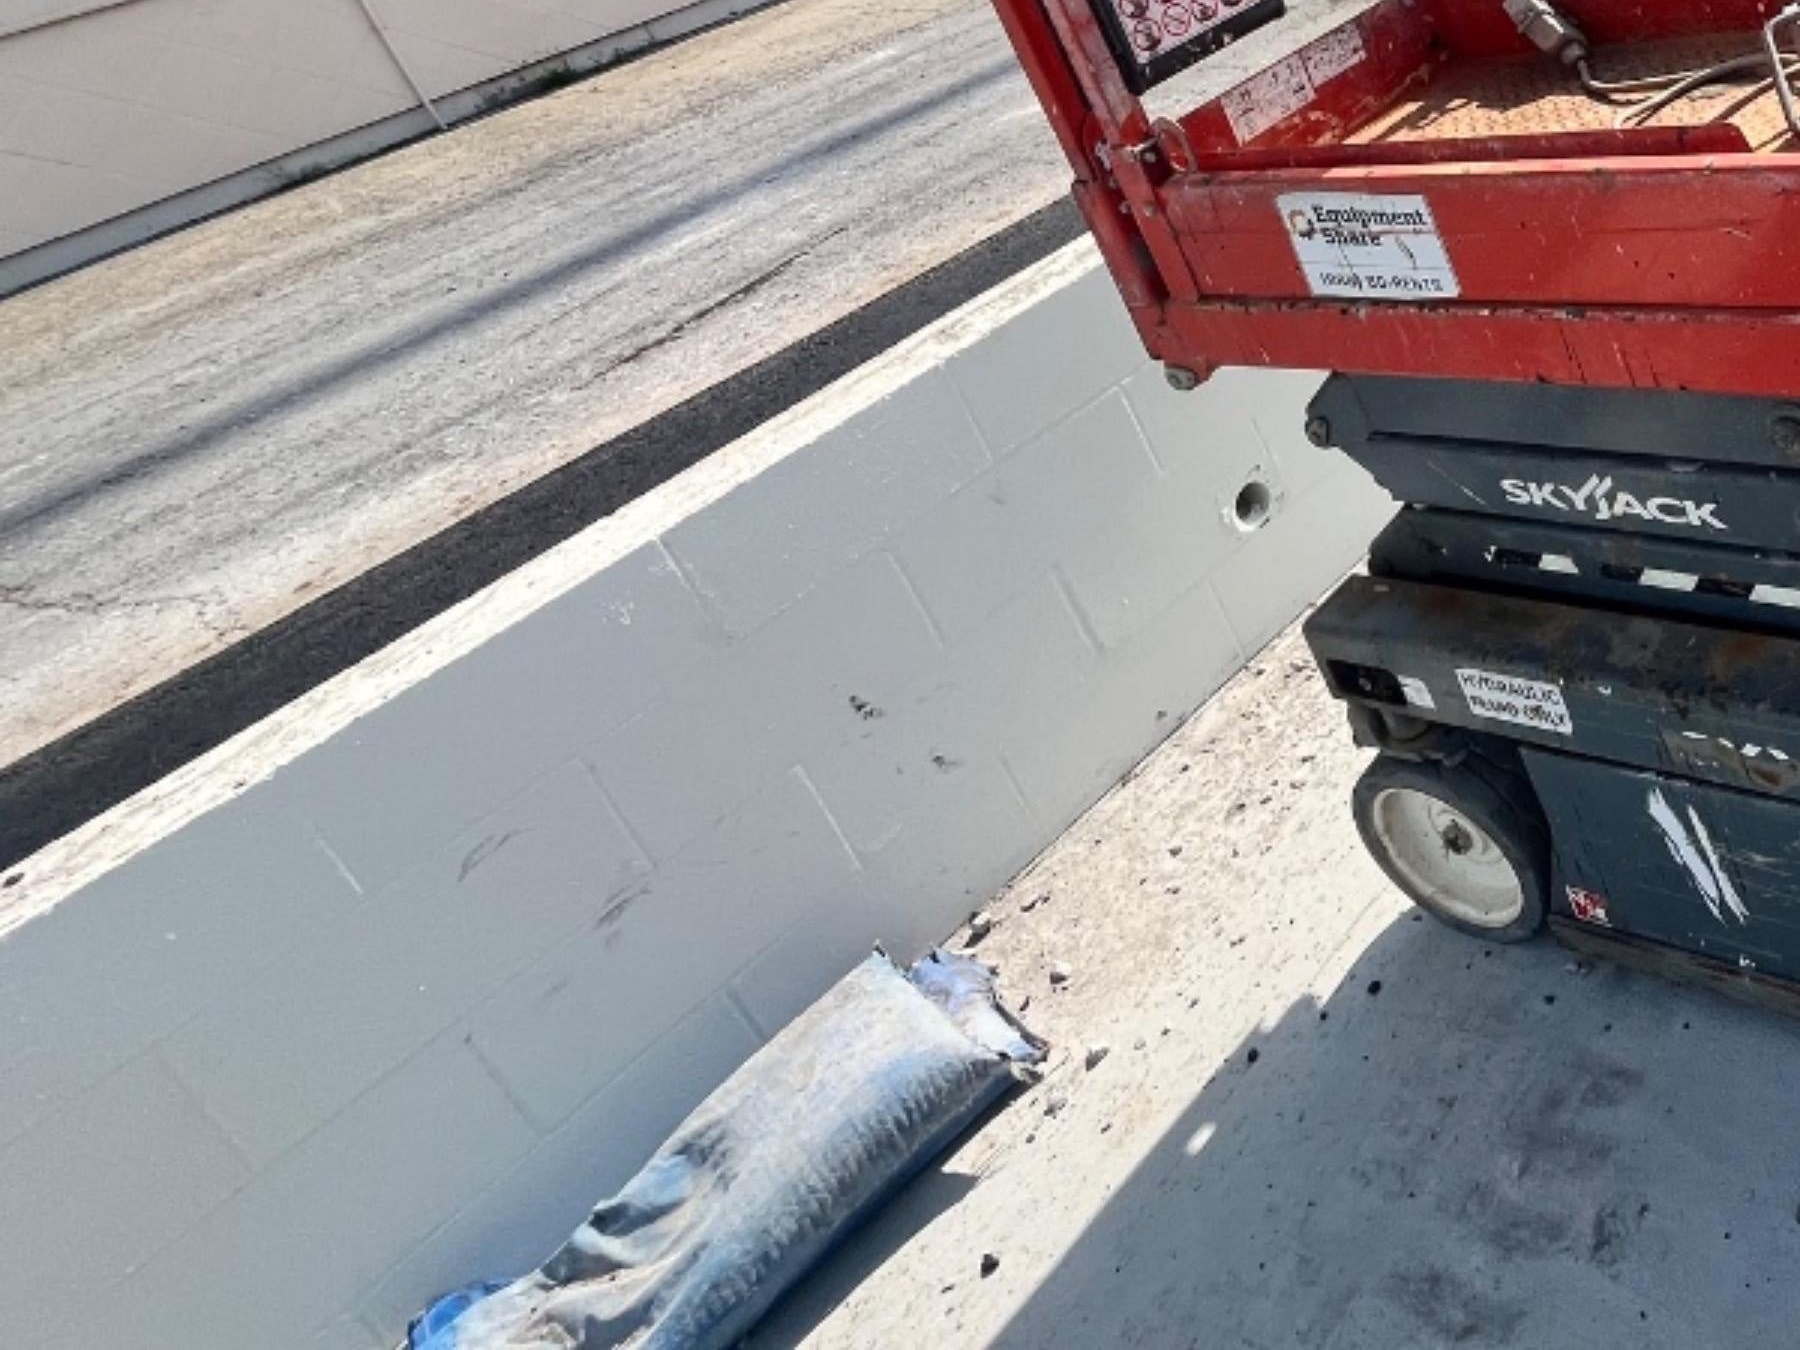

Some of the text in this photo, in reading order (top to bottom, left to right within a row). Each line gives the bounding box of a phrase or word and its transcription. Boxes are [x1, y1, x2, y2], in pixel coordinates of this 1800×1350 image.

[1311, 204, 1428, 228] Equipment
[1322, 227, 1382, 247] Share
[1500, 473, 1729, 529] SKYJACK
